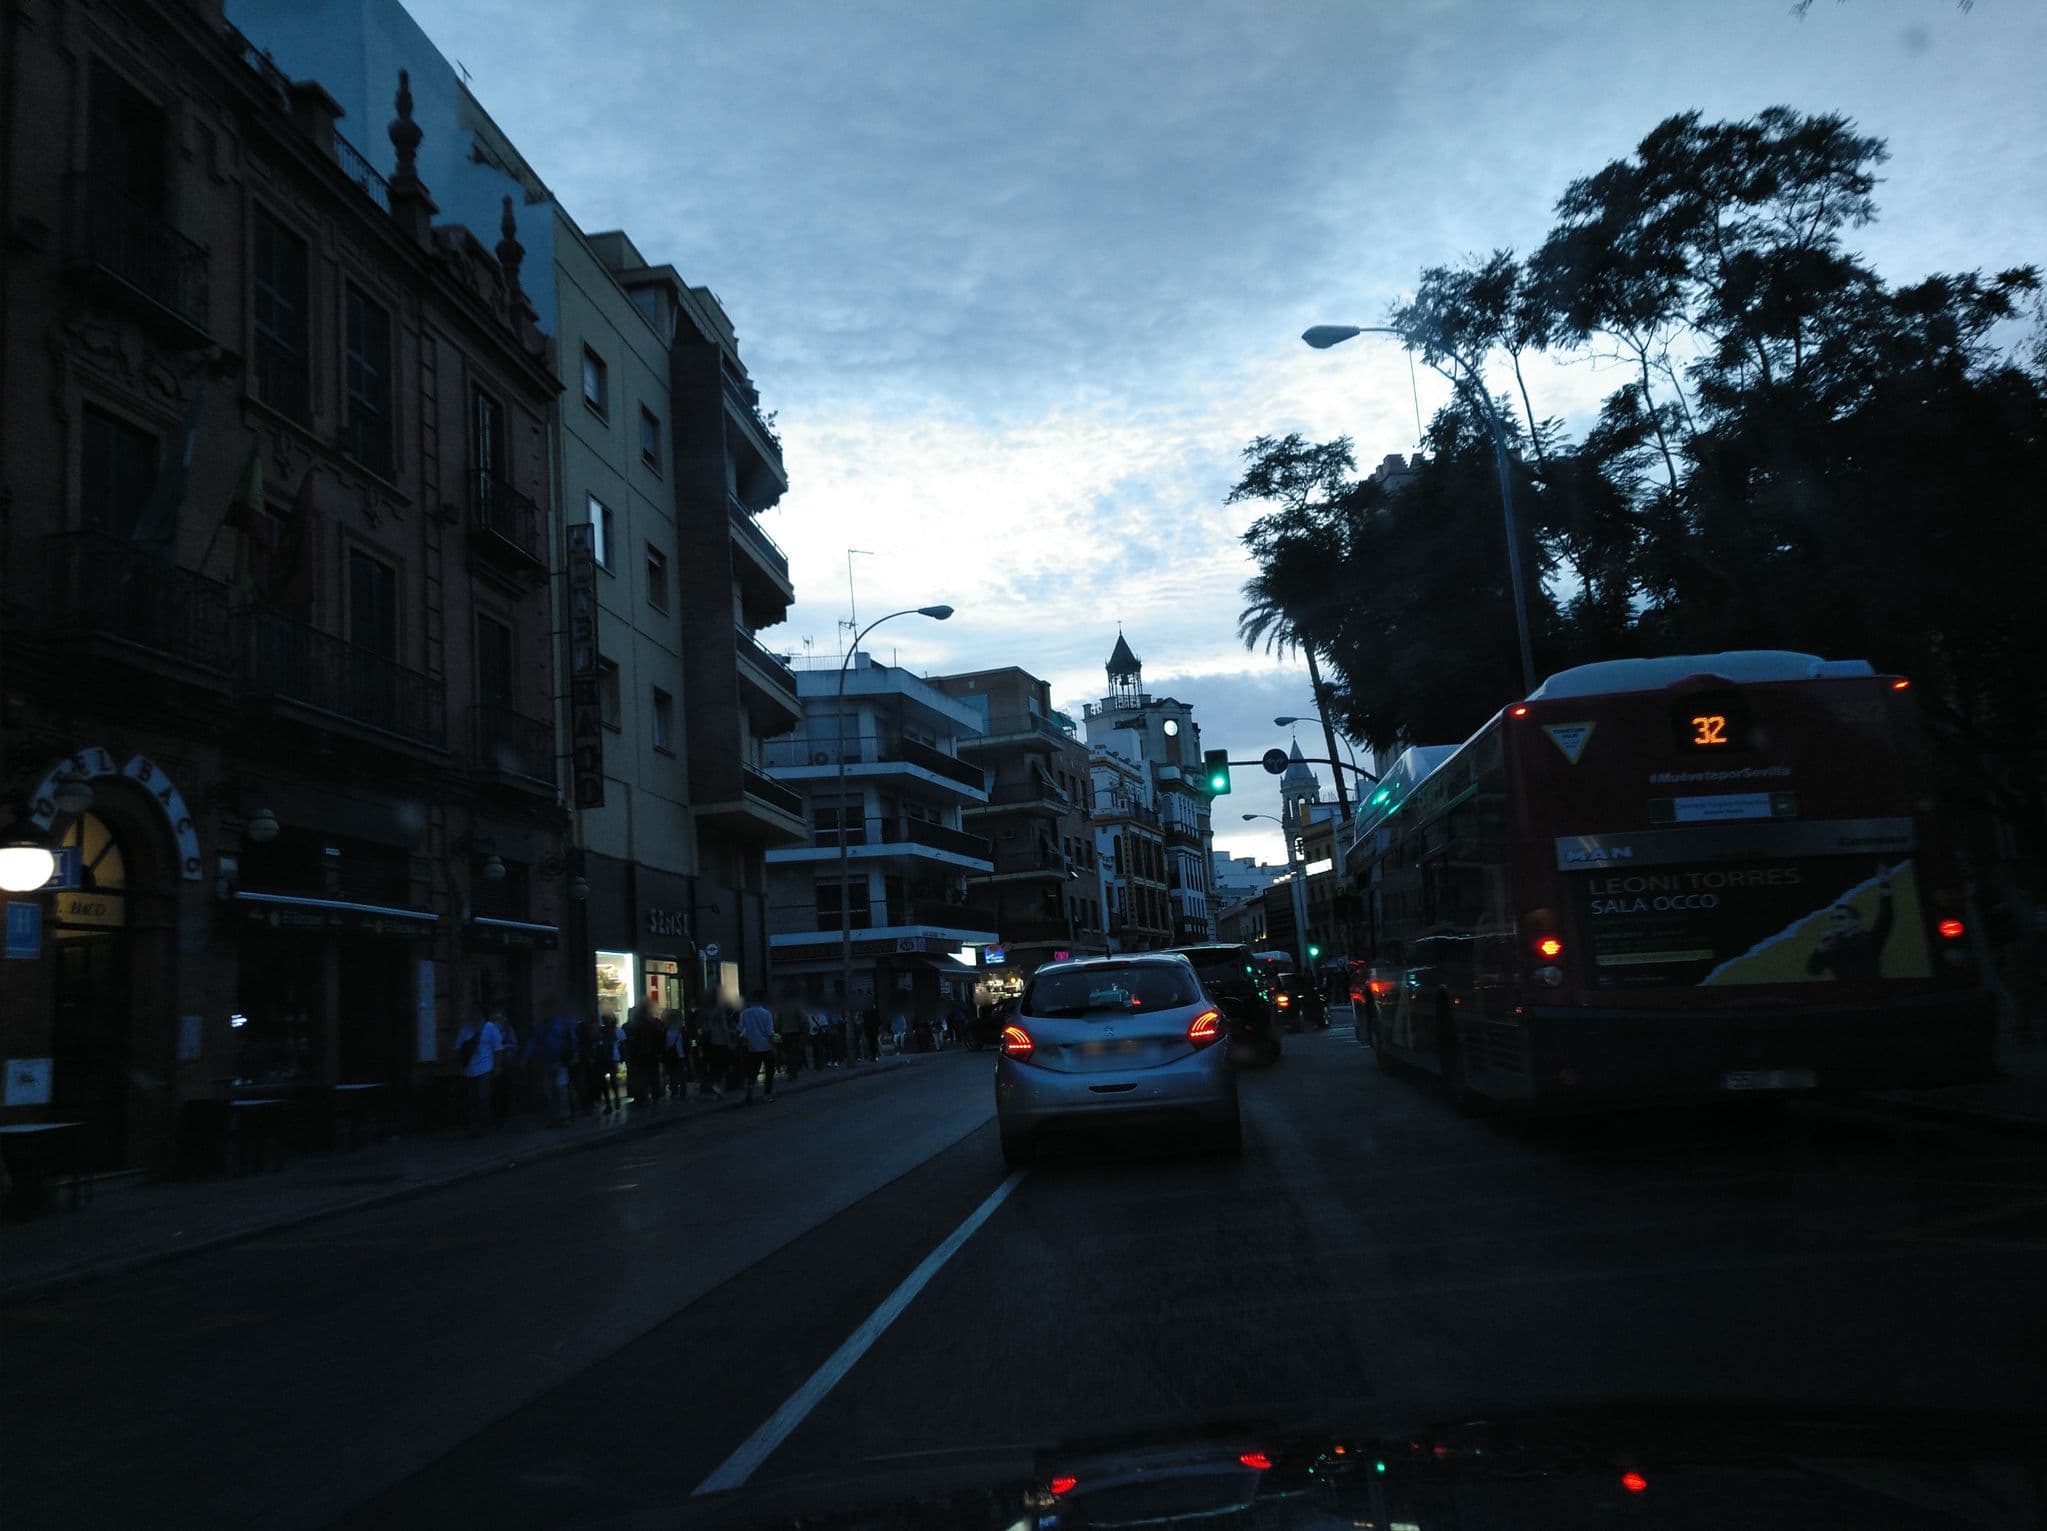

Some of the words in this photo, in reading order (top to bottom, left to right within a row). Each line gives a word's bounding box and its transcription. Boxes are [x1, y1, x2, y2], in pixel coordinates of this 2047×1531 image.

[1692, 715, 1728, 745] 32
[1687, 867, 1801, 889] TORRES
[1590, 896, 1649, 915] SALA
[1652, 894, 1721, 912] OCCO
